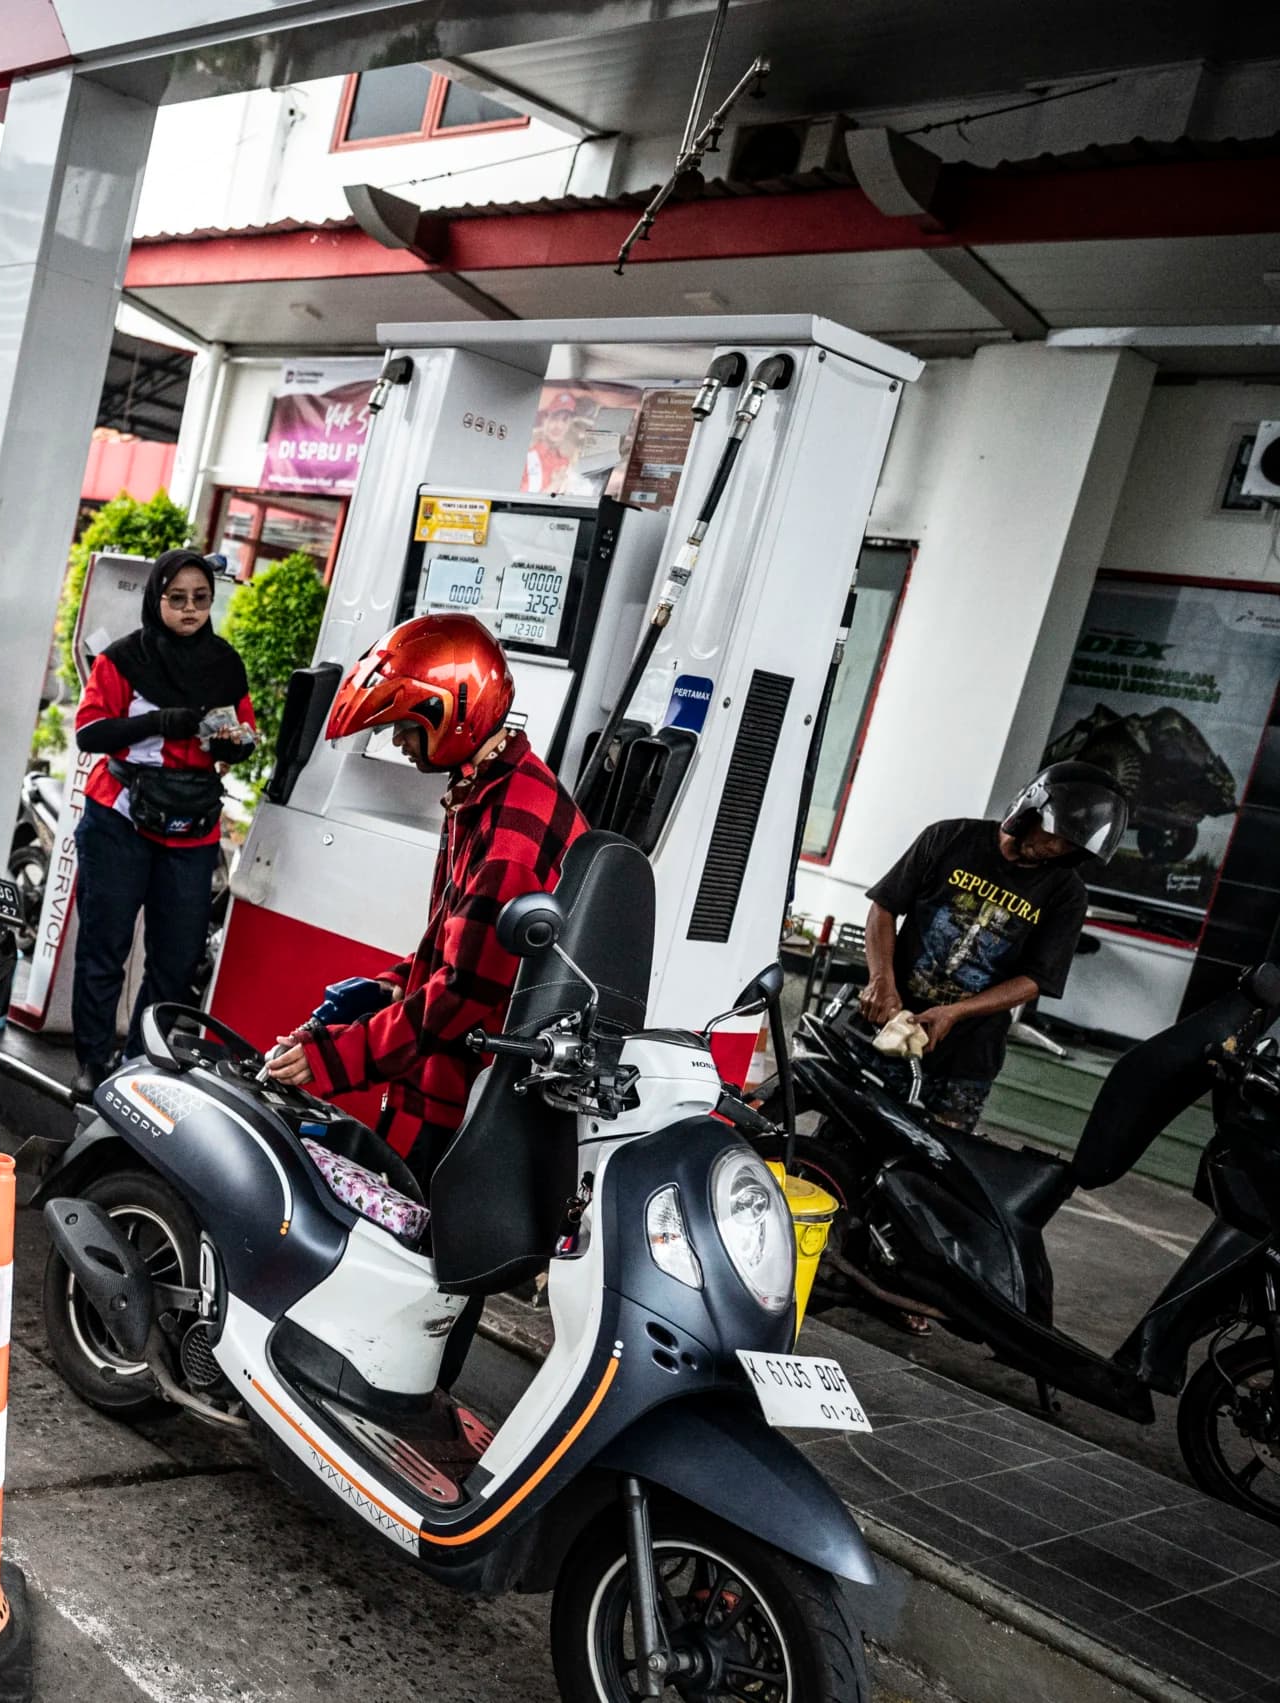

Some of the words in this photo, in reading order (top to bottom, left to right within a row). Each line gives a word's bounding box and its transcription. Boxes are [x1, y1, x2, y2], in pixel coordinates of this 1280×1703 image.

[324, 403, 354, 438] Yuk
[278, 440, 296, 459] DI
[298, 441, 341, 462] SPBU
[475, 566, 485, 585] 0
[535, 564, 557, 572] HARGA
[117, 580, 138, 592] SELF
[521, 572, 563, 594] 40000
[513, 623, 545, 639] 12300
[672, 660, 678, 670] 1
[673, 687, 711, 701] PERTAMAX
[70, 751, 93, 820] SELF
[42, 836, 78, 958] SERVICE
[948, 869, 1041, 925] SEPULTURA
[105, 1091, 162, 1138] SCOOPY
[744, 1356, 767, 1384] K
[765, 1359, 812, 1389] 6135
[814, 1364, 847, 1394] BDF
